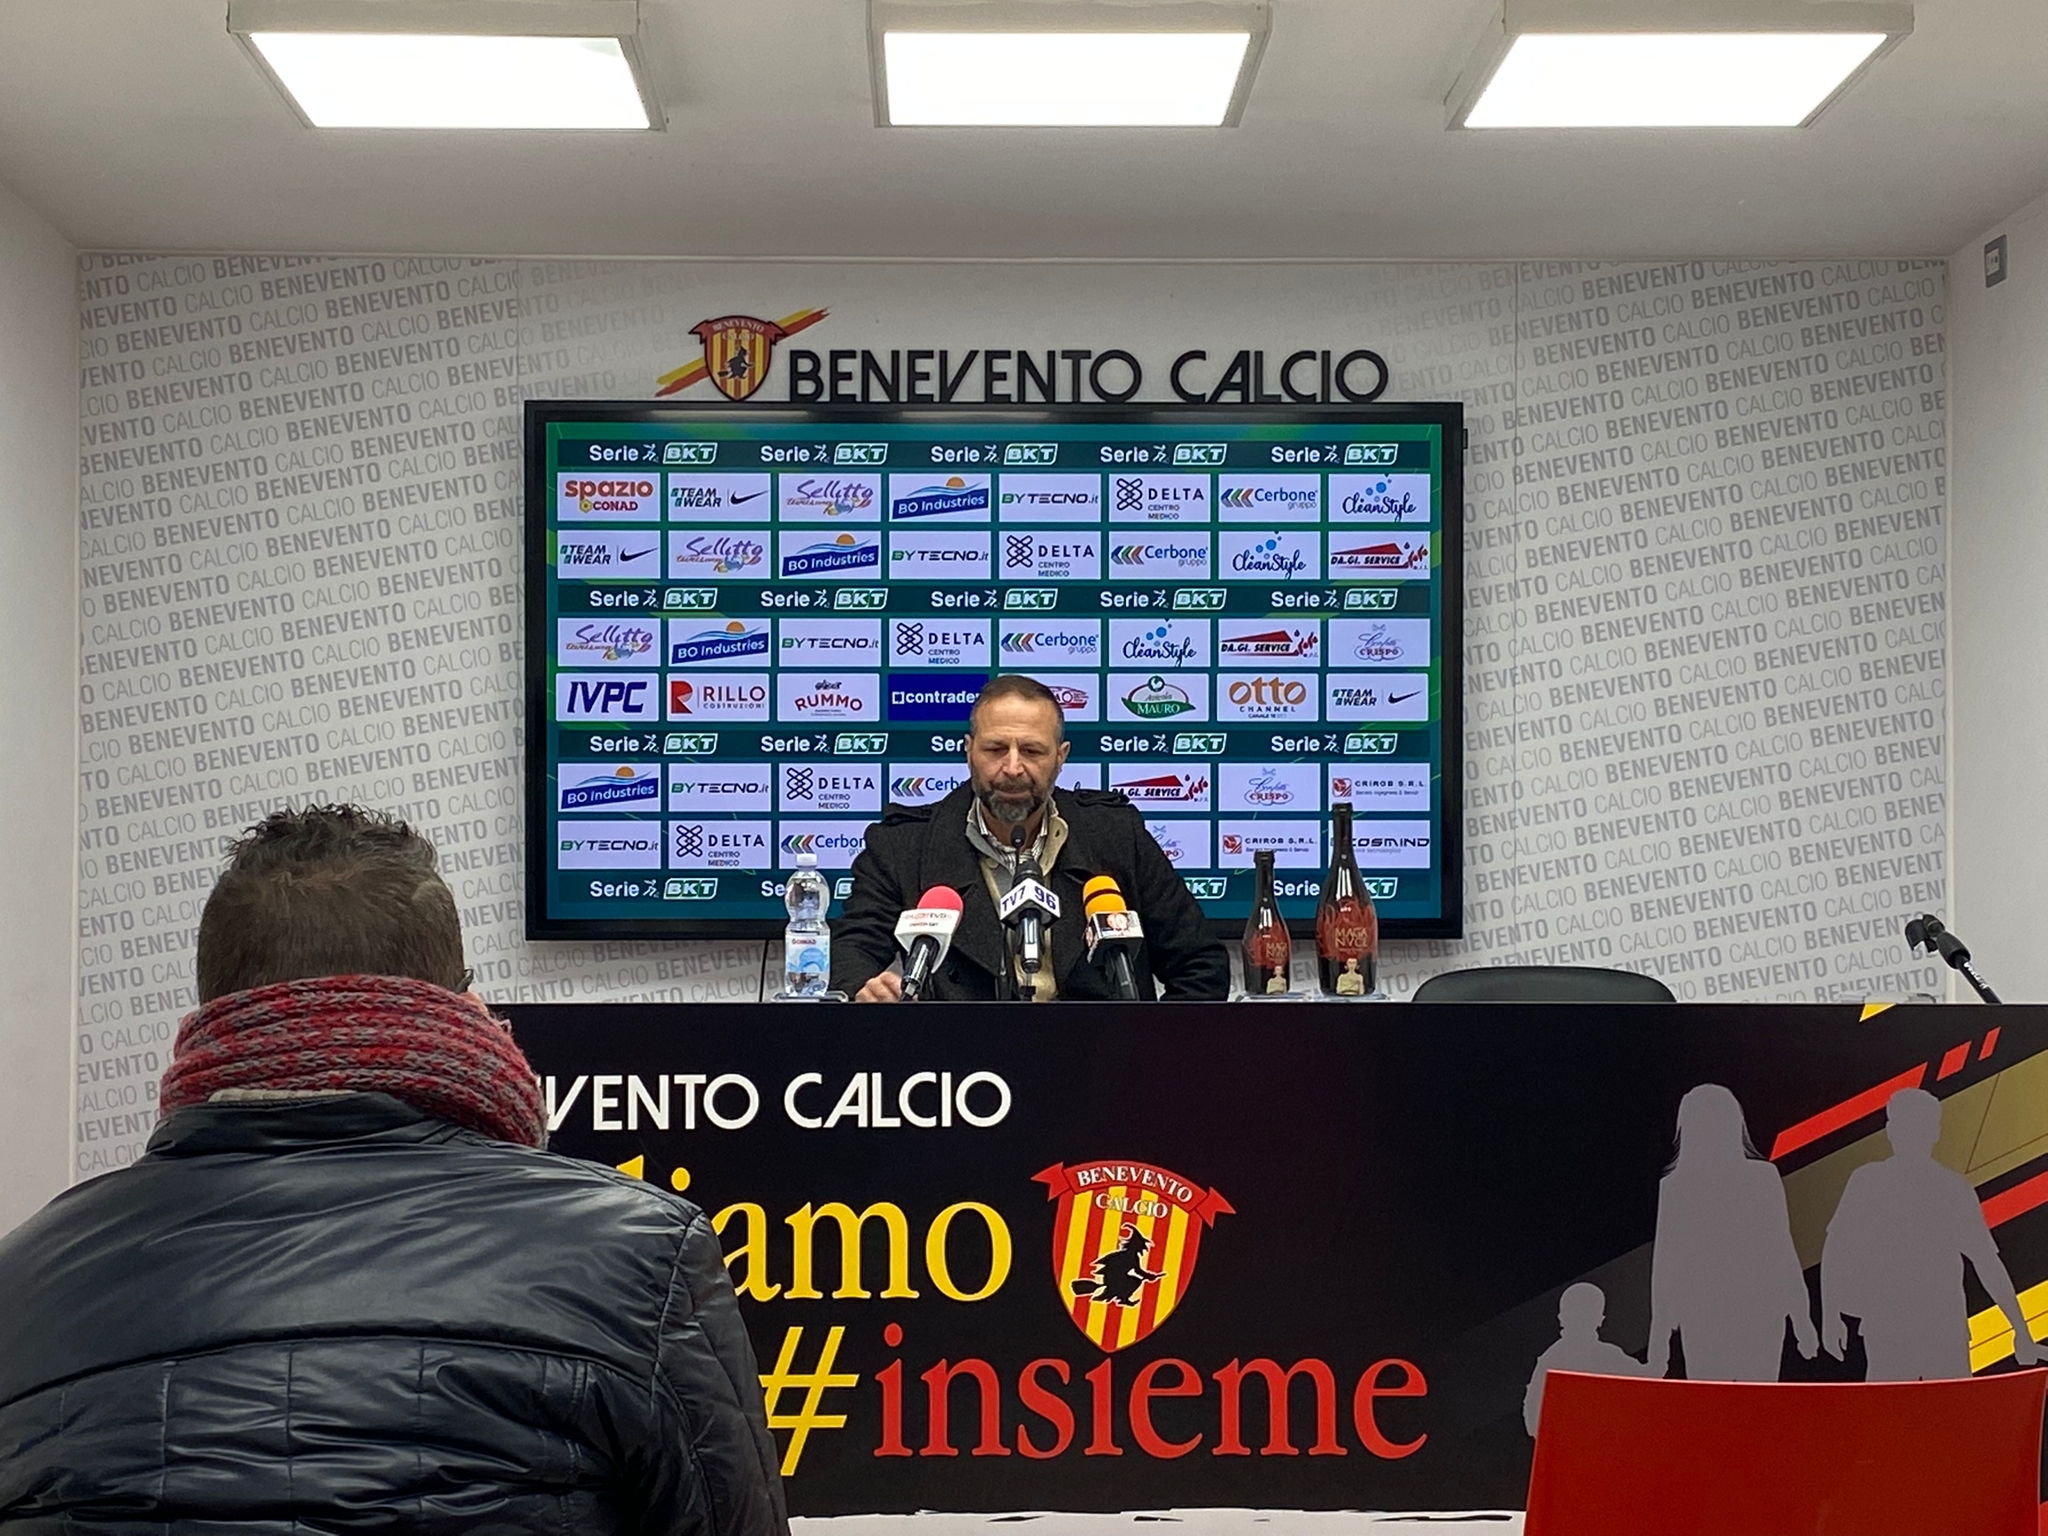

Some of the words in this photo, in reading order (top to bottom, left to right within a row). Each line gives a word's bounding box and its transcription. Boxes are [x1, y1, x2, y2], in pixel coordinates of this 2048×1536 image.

[185, 284, 253, 313] CALCIO
[260, 262, 385, 300] BENEVENTO
[1617, 296, 1684, 323] CALCIO
[1691, 270, 1814, 309] BENEVENTO
[117, 315, 242, 353] BENEVENTO
[249, 303, 318, 332] CALCIO
[326, 281, 451, 319] BENEVENTO
[1533, 327, 1656, 366] BENEVENTO
[1663, 314, 1730, 343] CALCIO
[1737, 290, 1860, 330] BENEVENTO
[152, 348, 221, 377] CALCIO
[229, 326, 354, 364] BENEVENTO
[362, 314, 430, 343] CALCIO
[1596, 344, 1719, 384] BENEVENTO
[1726, 333, 1794, 362] CALCIO
[1801, 308, 1924, 347] BENEVENTO
[126, 371, 253, 410] BENEVENTO
[260, 360, 329, 389] CALCIO
[335, 337, 460, 376] BENEVENTO
[788, 350, 1142, 402] BENEVENTO
[1170, 350, 1389, 402] CALCIO
[1630, 377, 1698, 406] CALCIO
[1705, 353, 1829, 393] BENEVENTO
[589, 445, 639, 462] Serie
[665, 445, 714, 461] BKT
[761, 445, 810, 462] Serie
[836, 445, 885, 461] BKT
[931, 446, 980, 462] Serie
[1006, 446, 1055, 462] BKT
[1100, 446, 1149, 462] Serie
[1175, 446, 1223, 462] BKT
[1271, 446, 1320, 462] Serie
[1346, 446, 1395, 462] BKT
[1148, 488, 1204, 500] DELTA
[1254, 488, 1316, 502] Cerbone
[593, 501, 638, 511] CONAD
[898, 502, 918, 514] BO
[921, 495, 985, 512] Industries
[1038, 546, 1094, 558] DELTA
[1144, 544, 1206, 558] Cerbone
[788, 558, 808, 572] BO
[811, 552, 875, 568] Industries
[1364, 556, 1401, 565] SERVICE
[104, 575, 230, 615] BENEVENTO
[589, 590, 639, 606] Serie
[665, 591, 714, 607] BKT
[761, 591, 810, 607] Serie
[836, 591, 885, 607] BKT
[931, 591, 980, 607] Serie
[1006, 592, 1055, 608] BKT
[1100, 591, 1149, 607] Serie
[1175, 592, 1223, 608] BKT
[1271, 592, 1320, 608] Serie
[1346, 592, 1395, 608] BKT
[92, 616, 162, 646] CALCIO
[168, 593, 295, 632] BENEVENTO
[204, 626, 274, 656] CALCIO
[282, 602, 406, 642] BENEVENTO
[928, 633, 984, 645] DELTA
[1034, 632, 1096, 646] Cerbone
[678, 646, 698, 659] BO
[701, 640, 765, 656] Industries
[1254, 644, 1291, 652] SERVICE
[1360, 648, 1399, 656] CRISPO
[567, 682, 648, 714] IVPC
[703, 686, 766, 702] RILLO
[1229, 676, 1306, 704] otto
[795, 694, 862, 712] RUMMO
[1137, 703, 1180, 714] MAURO
[128, 716, 254, 755] BENEVENTO
[262, 704, 330, 734] CALCIO
[1559, 724, 1682, 763] BENEVENTO
[1689, 712, 1757, 741] CALCIO
[589, 736, 639, 752] Serie
[665, 736, 714, 752] BKT
[761, 736, 810, 752] Serie
[836, 736, 885, 752] BKT
[931, 736, 964, 752] Ser
[1100, 736, 1149, 752] Serie
[1175, 737, 1223, 753] BKT
[1271, 736, 1320, 752] Serie
[1346, 737, 1395, 753] BKT
[306, 743, 430, 783] BENEVENTO
[1605, 744, 1729, 784] BENEVENTO
[818, 778, 874, 790] DELTA
[925, 776, 966, 791] Cerb
[1669, 762, 1792, 801] BENEVENTO
[567, 792, 588, 804] BO
[590, 784, 655, 801] Industries
[1144, 788, 1181, 796] SERVICE
[1250, 792, 1289, 801] CRISPO
[1704, 795, 1772, 824] CALCIO
[1778, 772, 1902, 811] BENEVENTO
[708, 834, 764, 846] DELTA
[815, 834, 867, 848] Cerbon
[589, 880, 640, 896] Serie
[665, 881, 714, 897] BKT
[1273, 880, 1320, 896] Serie
[1366, 881, 1395, 896] KT
[1584, 862, 1707, 901] BENEVENTO
[1002, 886, 1026, 912] TV7
[1034, 885, 1057, 911] 96
[1704, 958, 1828, 996] BENEVENTO
[784, 1071, 1012, 1128] CALCIO
[1076, 1165, 1193, 1203] BENEVENTO
[1095, 1192, 1169, 1219] CALCIO
